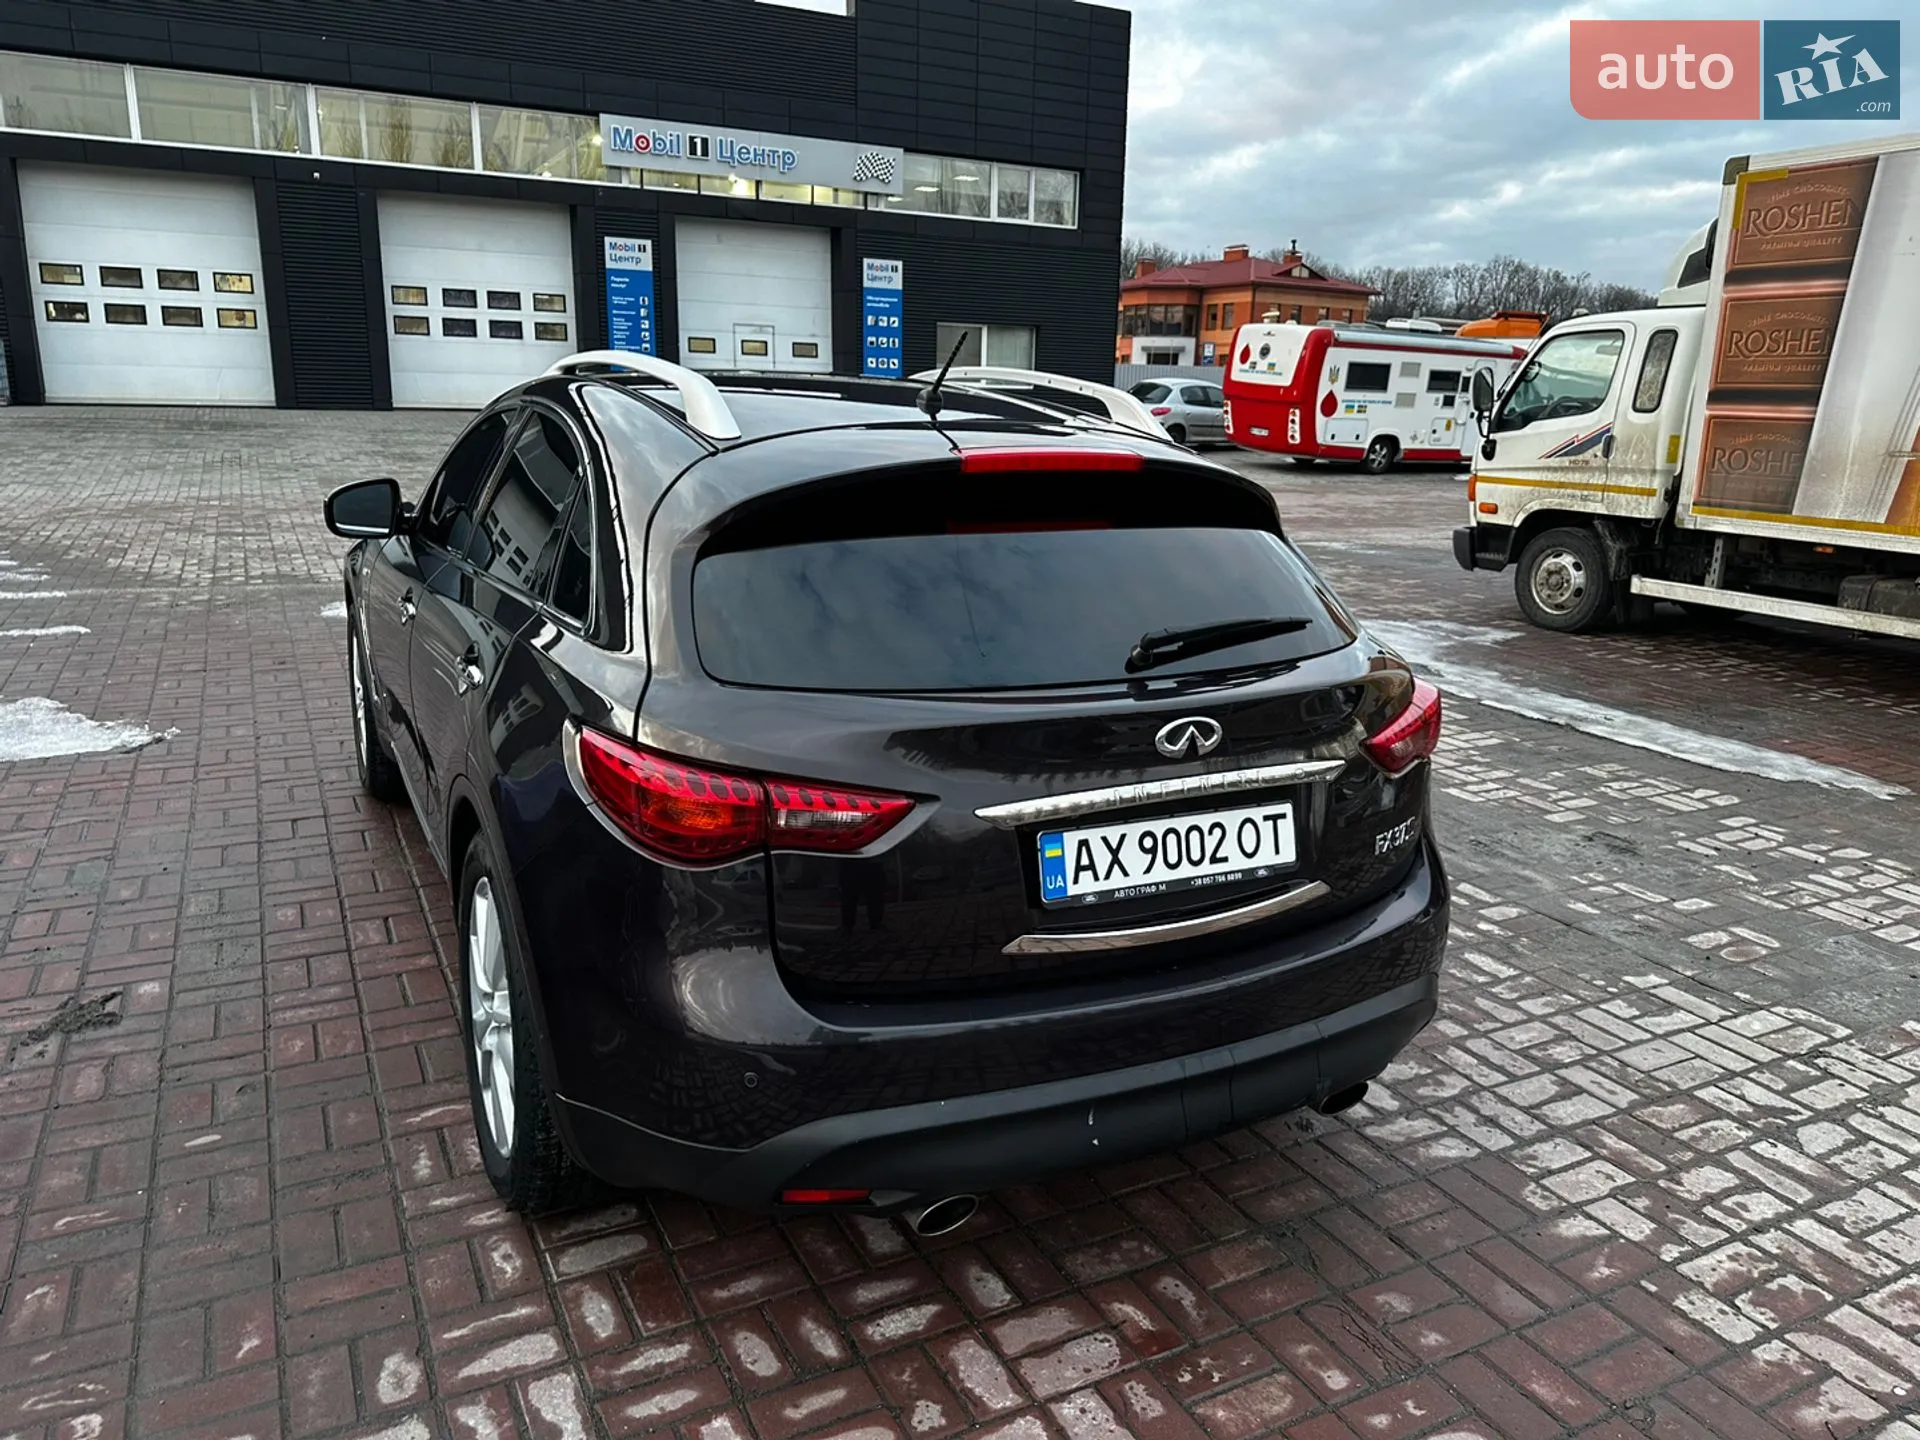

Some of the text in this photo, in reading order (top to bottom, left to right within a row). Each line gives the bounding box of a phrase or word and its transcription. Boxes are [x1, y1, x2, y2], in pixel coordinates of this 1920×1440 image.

[610, 124, 682, 158] Mobil
[717, 136, 799, 172] Центр
[608, 241, 636, 253] Mobil
[609, 253, 642, 266] Центр
[1113, 770, 1263, 804] INFINITI
[1072, 812, 1287, 885] AX 9002 OT
[1046, 876, 1065, 889] UA
